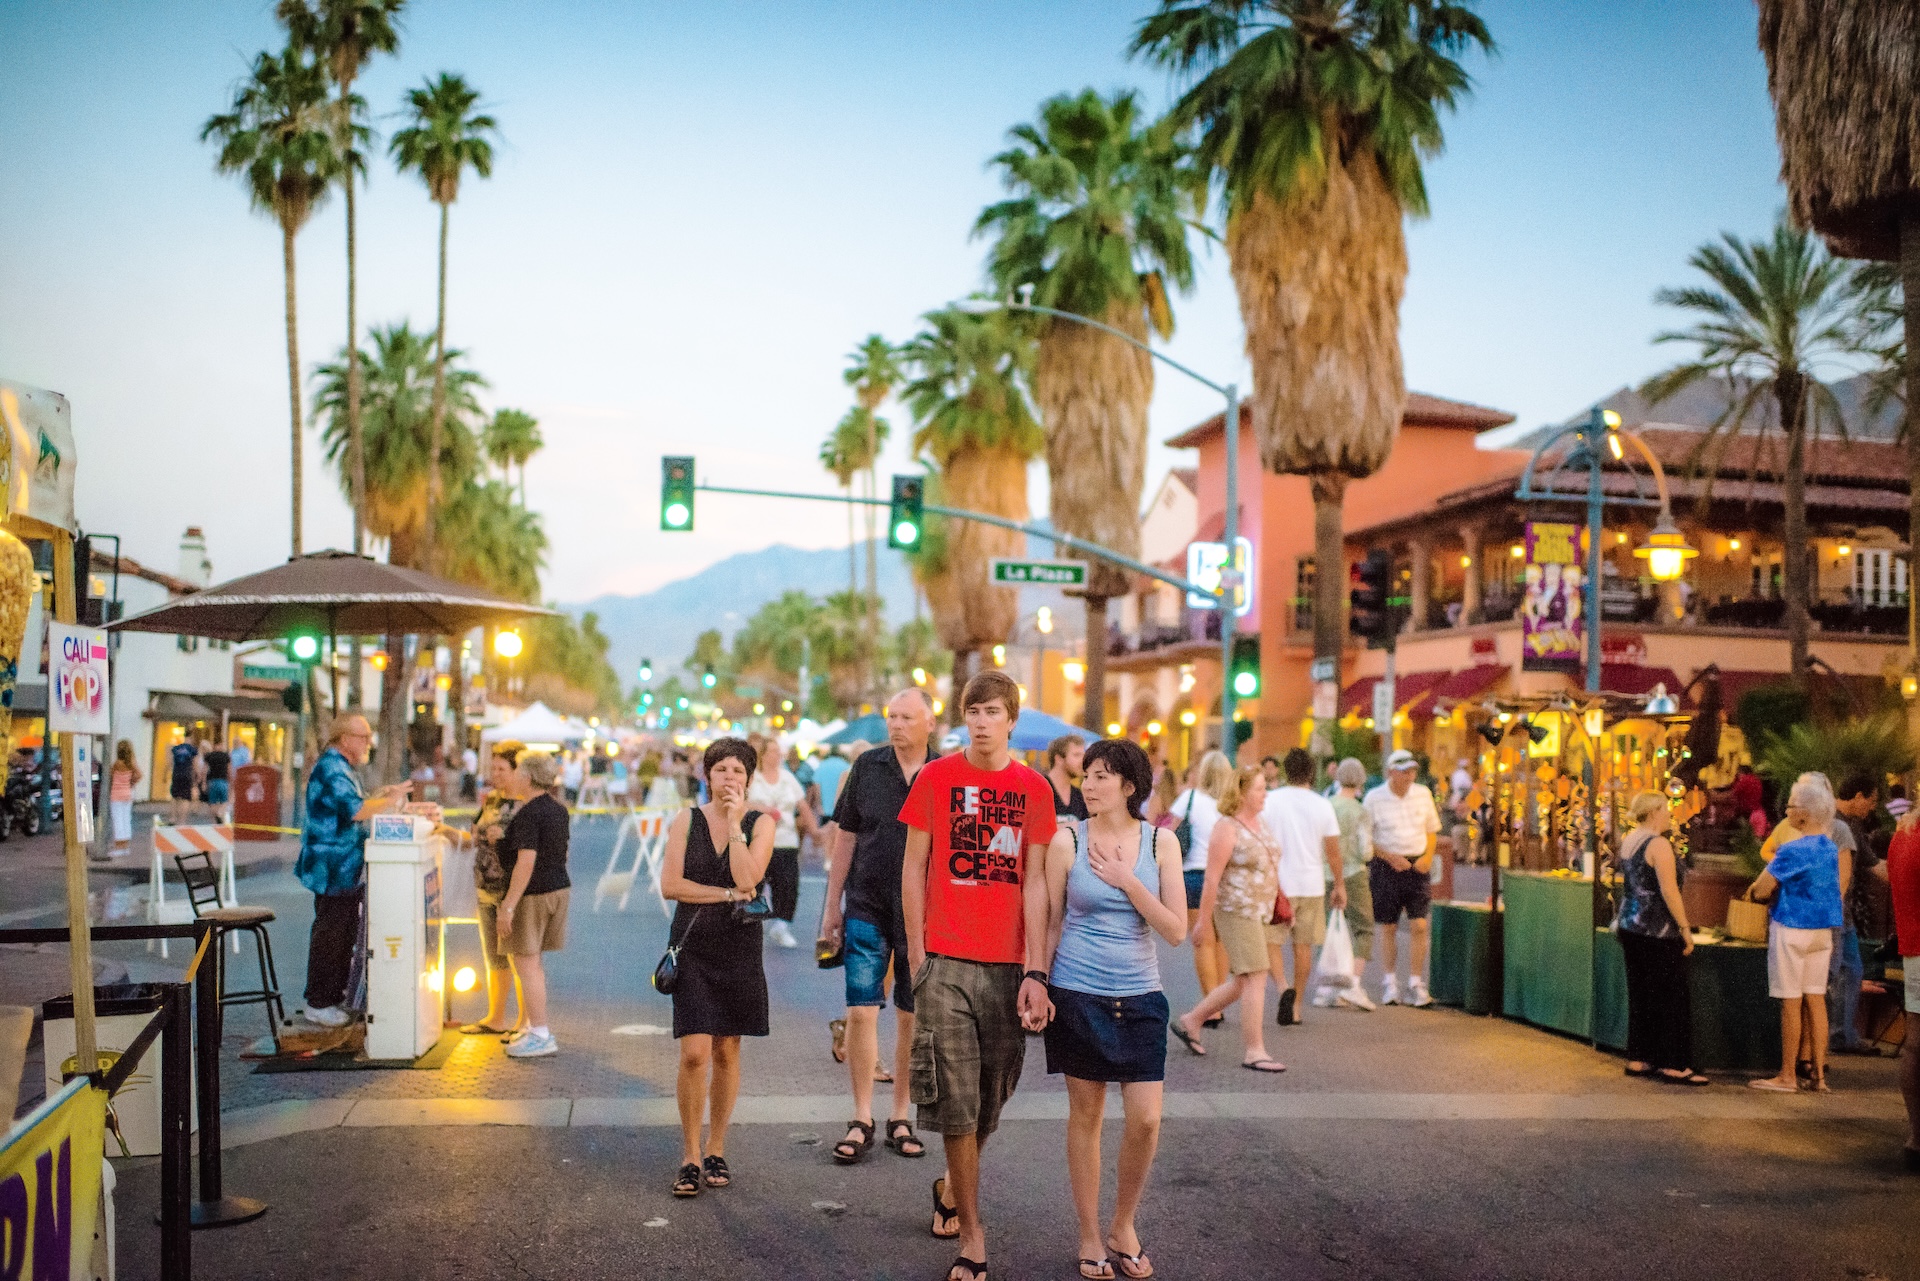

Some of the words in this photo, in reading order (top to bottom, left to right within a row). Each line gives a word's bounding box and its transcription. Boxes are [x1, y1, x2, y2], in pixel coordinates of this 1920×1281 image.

[1005, 565, 1025, 580] La
[1031, 567, 1074, 582] Plaza
[63, 636, 89, 664] CALI
[60, 666, 100, 711] POP
